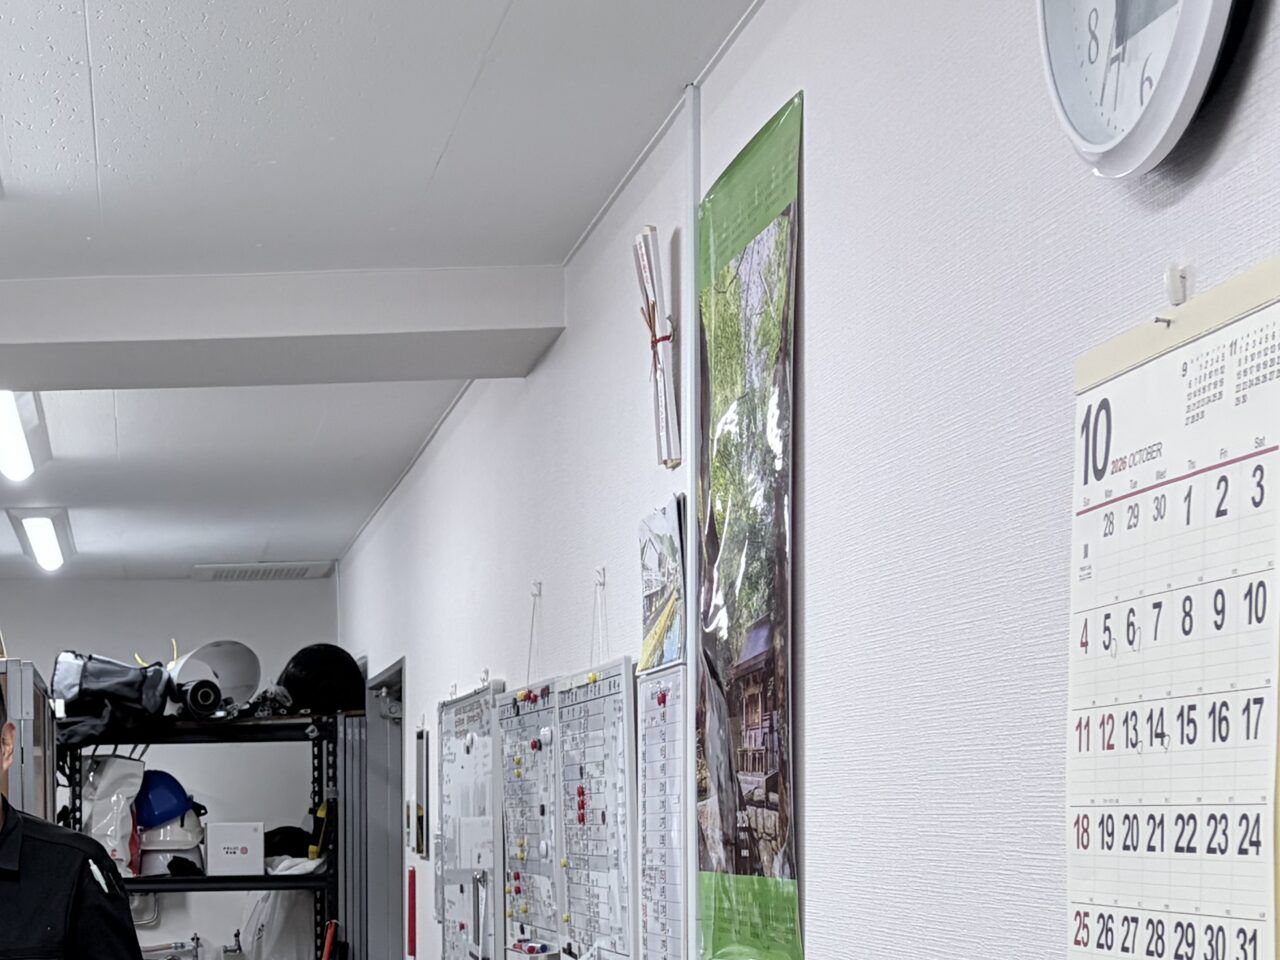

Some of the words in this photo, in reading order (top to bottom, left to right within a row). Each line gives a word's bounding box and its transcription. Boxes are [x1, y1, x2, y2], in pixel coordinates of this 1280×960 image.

[1088, 8, 1099, 64] 8
[1080, 397, 1112, 486] 10
[1128, 442, 1163, 466] OCTOBER
[1103, 511, 1115, 538] 28
[1127, 502, 1140, 530] 29
[1153, 494, 1166, 522] 30
[1184, 484, 1193, 526] 1
[1215, 475, 1229, 518] 2
[1251, 464, 1265, 508] 3
[1080, 618, 1089, 654] 4
[1103, 613, 1112, 650] 5
[1126, 608, 1136, 646] 6
[1152, 601, 1162, 641] 7
[1182, 595, 1193, 636] 8
[1213, 588, 1226, 631] 9
[1244, 580, 1266, 625] 10
[1075, 715, 1090, 752] 11
[1099, 713, 1115, 751] 12
[1122, 710, 1138, 749] 13
[1146, 708, 1166, 747] 14
[1176, 704, 1197, 745] 15
[1208, 700, 1230, 743] 16
[1242, 697, 1264, 740] 17
[1073, 813, 1090, 850] 18
[1098, 813, 1115, 851] 19
[1122, 814, 1139, 852] 20
[1146, 813, 1165, 852] 21
[1174, 813, 1197, 853] 22
[1206, 813, 1229, 854] 23
[1237, 813, 1261, 856] 24
[1073, 910, 1090, 948] 25
[1096, 913, 1114, 951] 26
[1121, 916, 1139, 954] 27
[1145, 918, 1165, 958] 28
